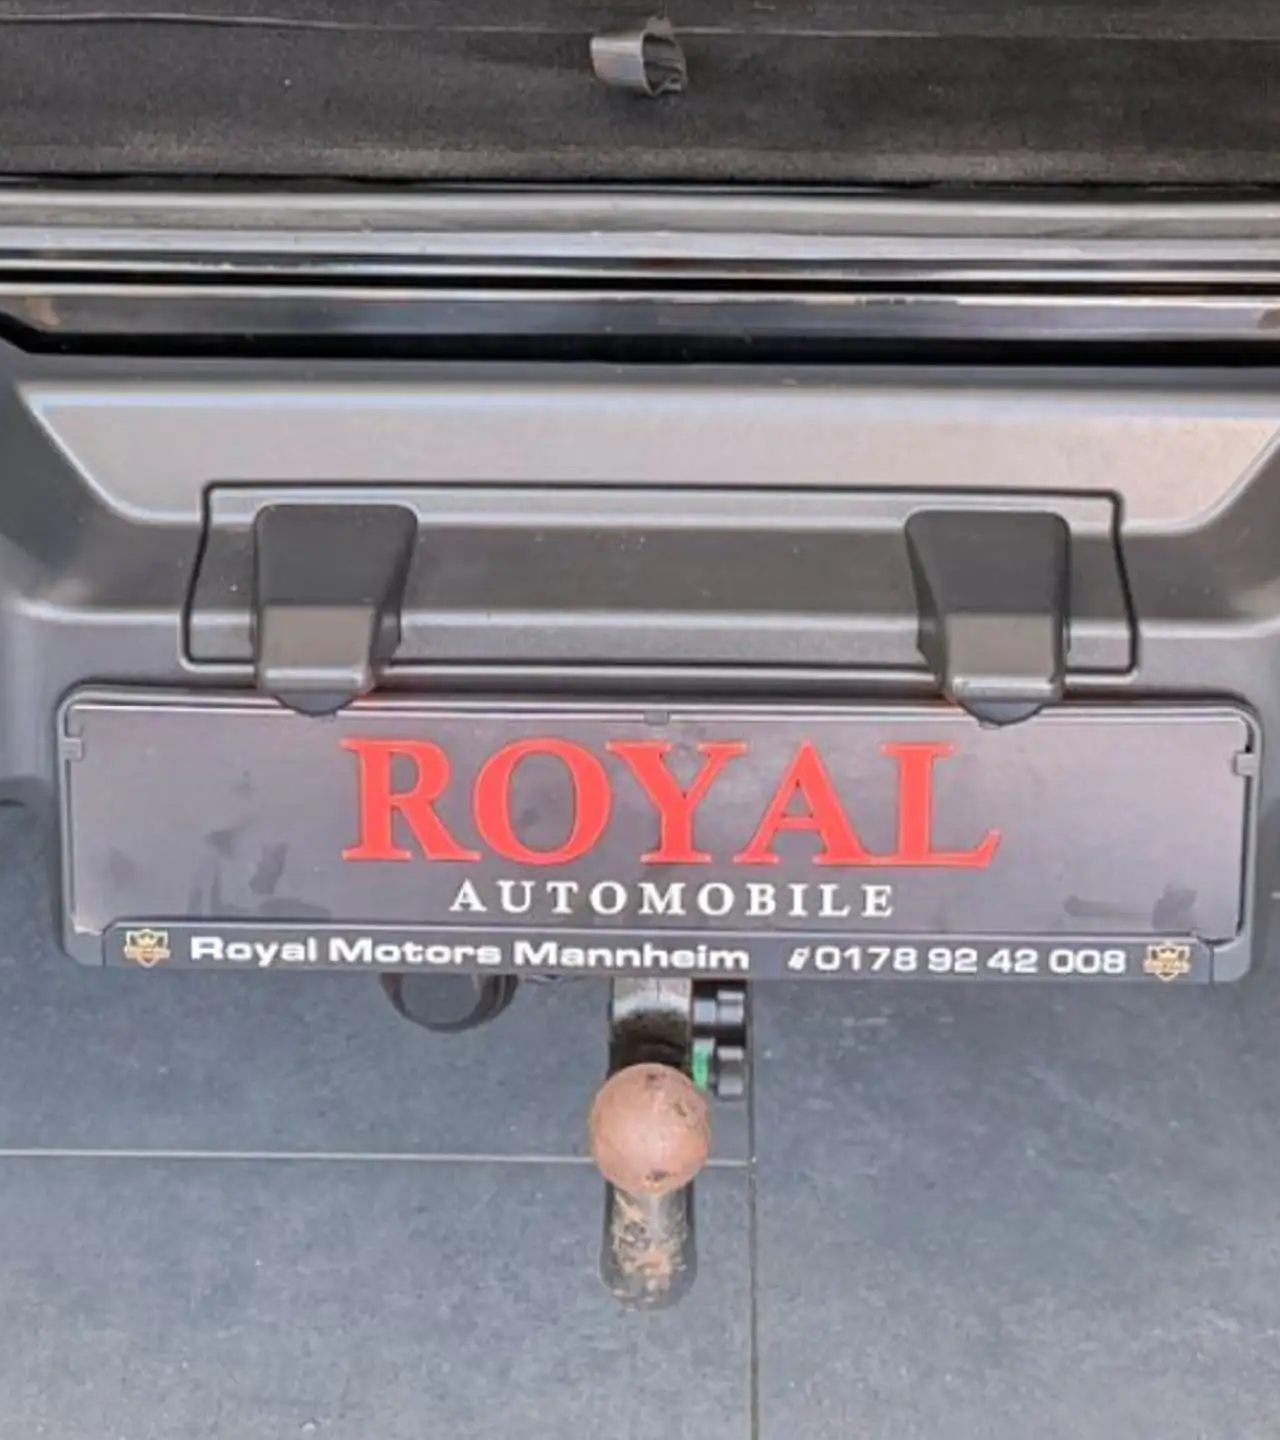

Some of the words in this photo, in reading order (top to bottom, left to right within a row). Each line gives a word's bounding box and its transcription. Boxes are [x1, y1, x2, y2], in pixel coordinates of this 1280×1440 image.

[341, 736, 1000, 869] ROYAL
[449, 880, 893, 918] AUTOMOBILE
[191, 936, 318, 967] Royal
[329, 937, 502, 964] Motors
[514, 941, 749, 969] Mannheim
[815, 946, 917, 972] 0178
[928, 947, 978, 972] 92
[987, 948, 1038, 973] 42
[1049, 949, 1126, 974] 008
